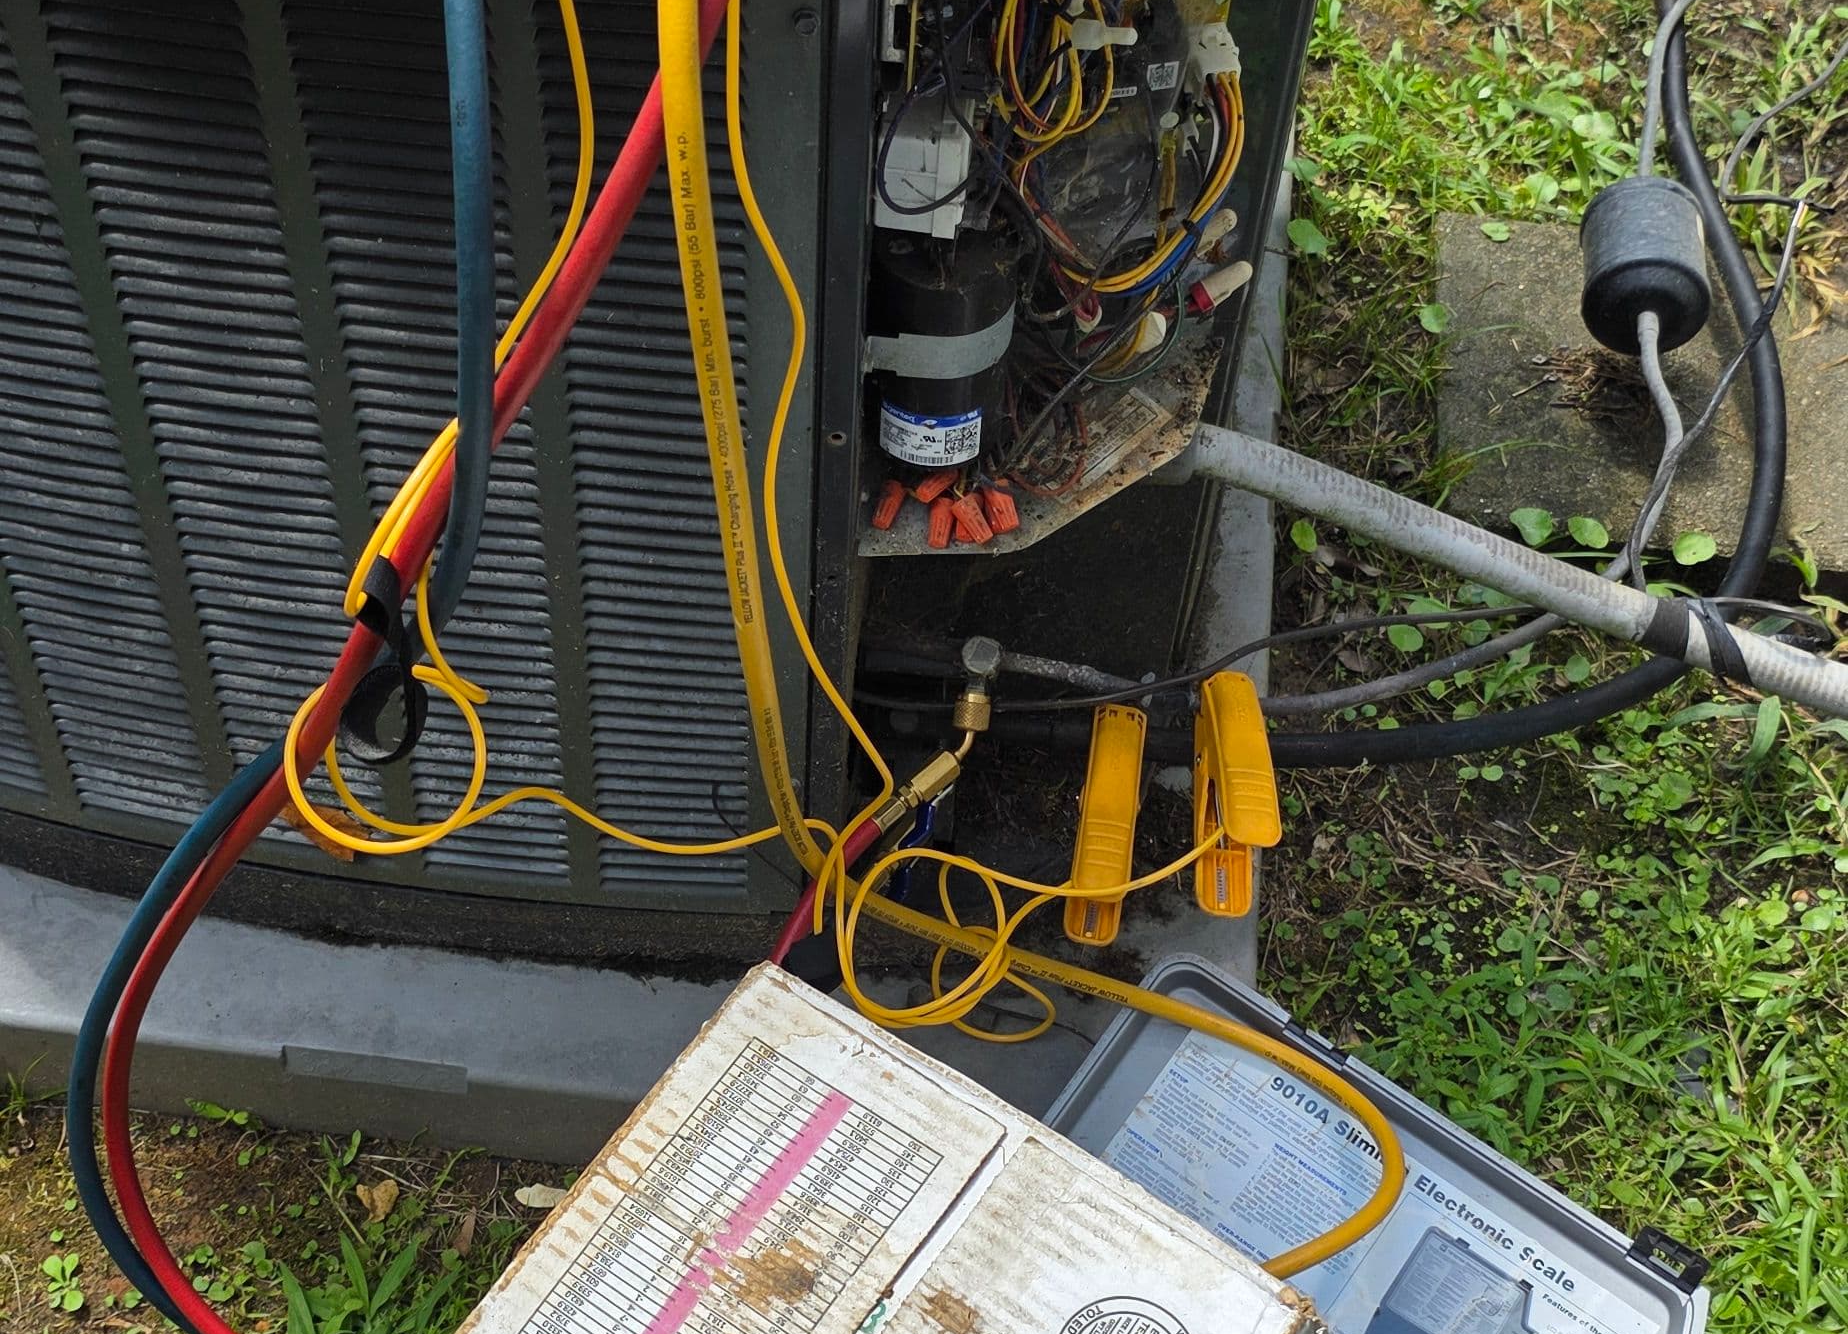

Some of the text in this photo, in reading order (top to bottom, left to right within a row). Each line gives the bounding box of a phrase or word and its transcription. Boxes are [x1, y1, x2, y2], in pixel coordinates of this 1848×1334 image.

[694, 258, 706, 301] 800psi
[727, 493, 741, 531] Charging
[1099, 988, 1129, 1003] YELLOW
[782, 1101, 796, 1112] 57
[1267, 1074, 1333, 1125] 9010A
[776, 1110, 788, 1121] 54
[861, 1110, 883, 1128] 611.9
[761, 1126, 775, 1138] 49
[854, 1120, 876, 1137] 575.1
[833, 1146, 856, 1164] 475.4
[840, 1137, 863, 1155] 506.9
[847, 1128, 909, 1171] 140 540.1
[819, 1163, 842, 1181] 416.9
[886, 1166, 902, 1180] 135
[1272, 1142, 1348, 1197] WEIGHT MEASUREMENTS
[878, 1175, 896, 1189] 130
[865, 1192, 882, 1207] 120
[1411, 1173, 1519, 1252] Electronic
[1516, 1244, 1580, 1294] Scale
[1540, 1292, 1579, 1322] Features
[548, 1308, 571, 1327] 379.2
[618, 1312, 630, 1324] -7
[1120, 1316, 1132, 1330] SIZE
